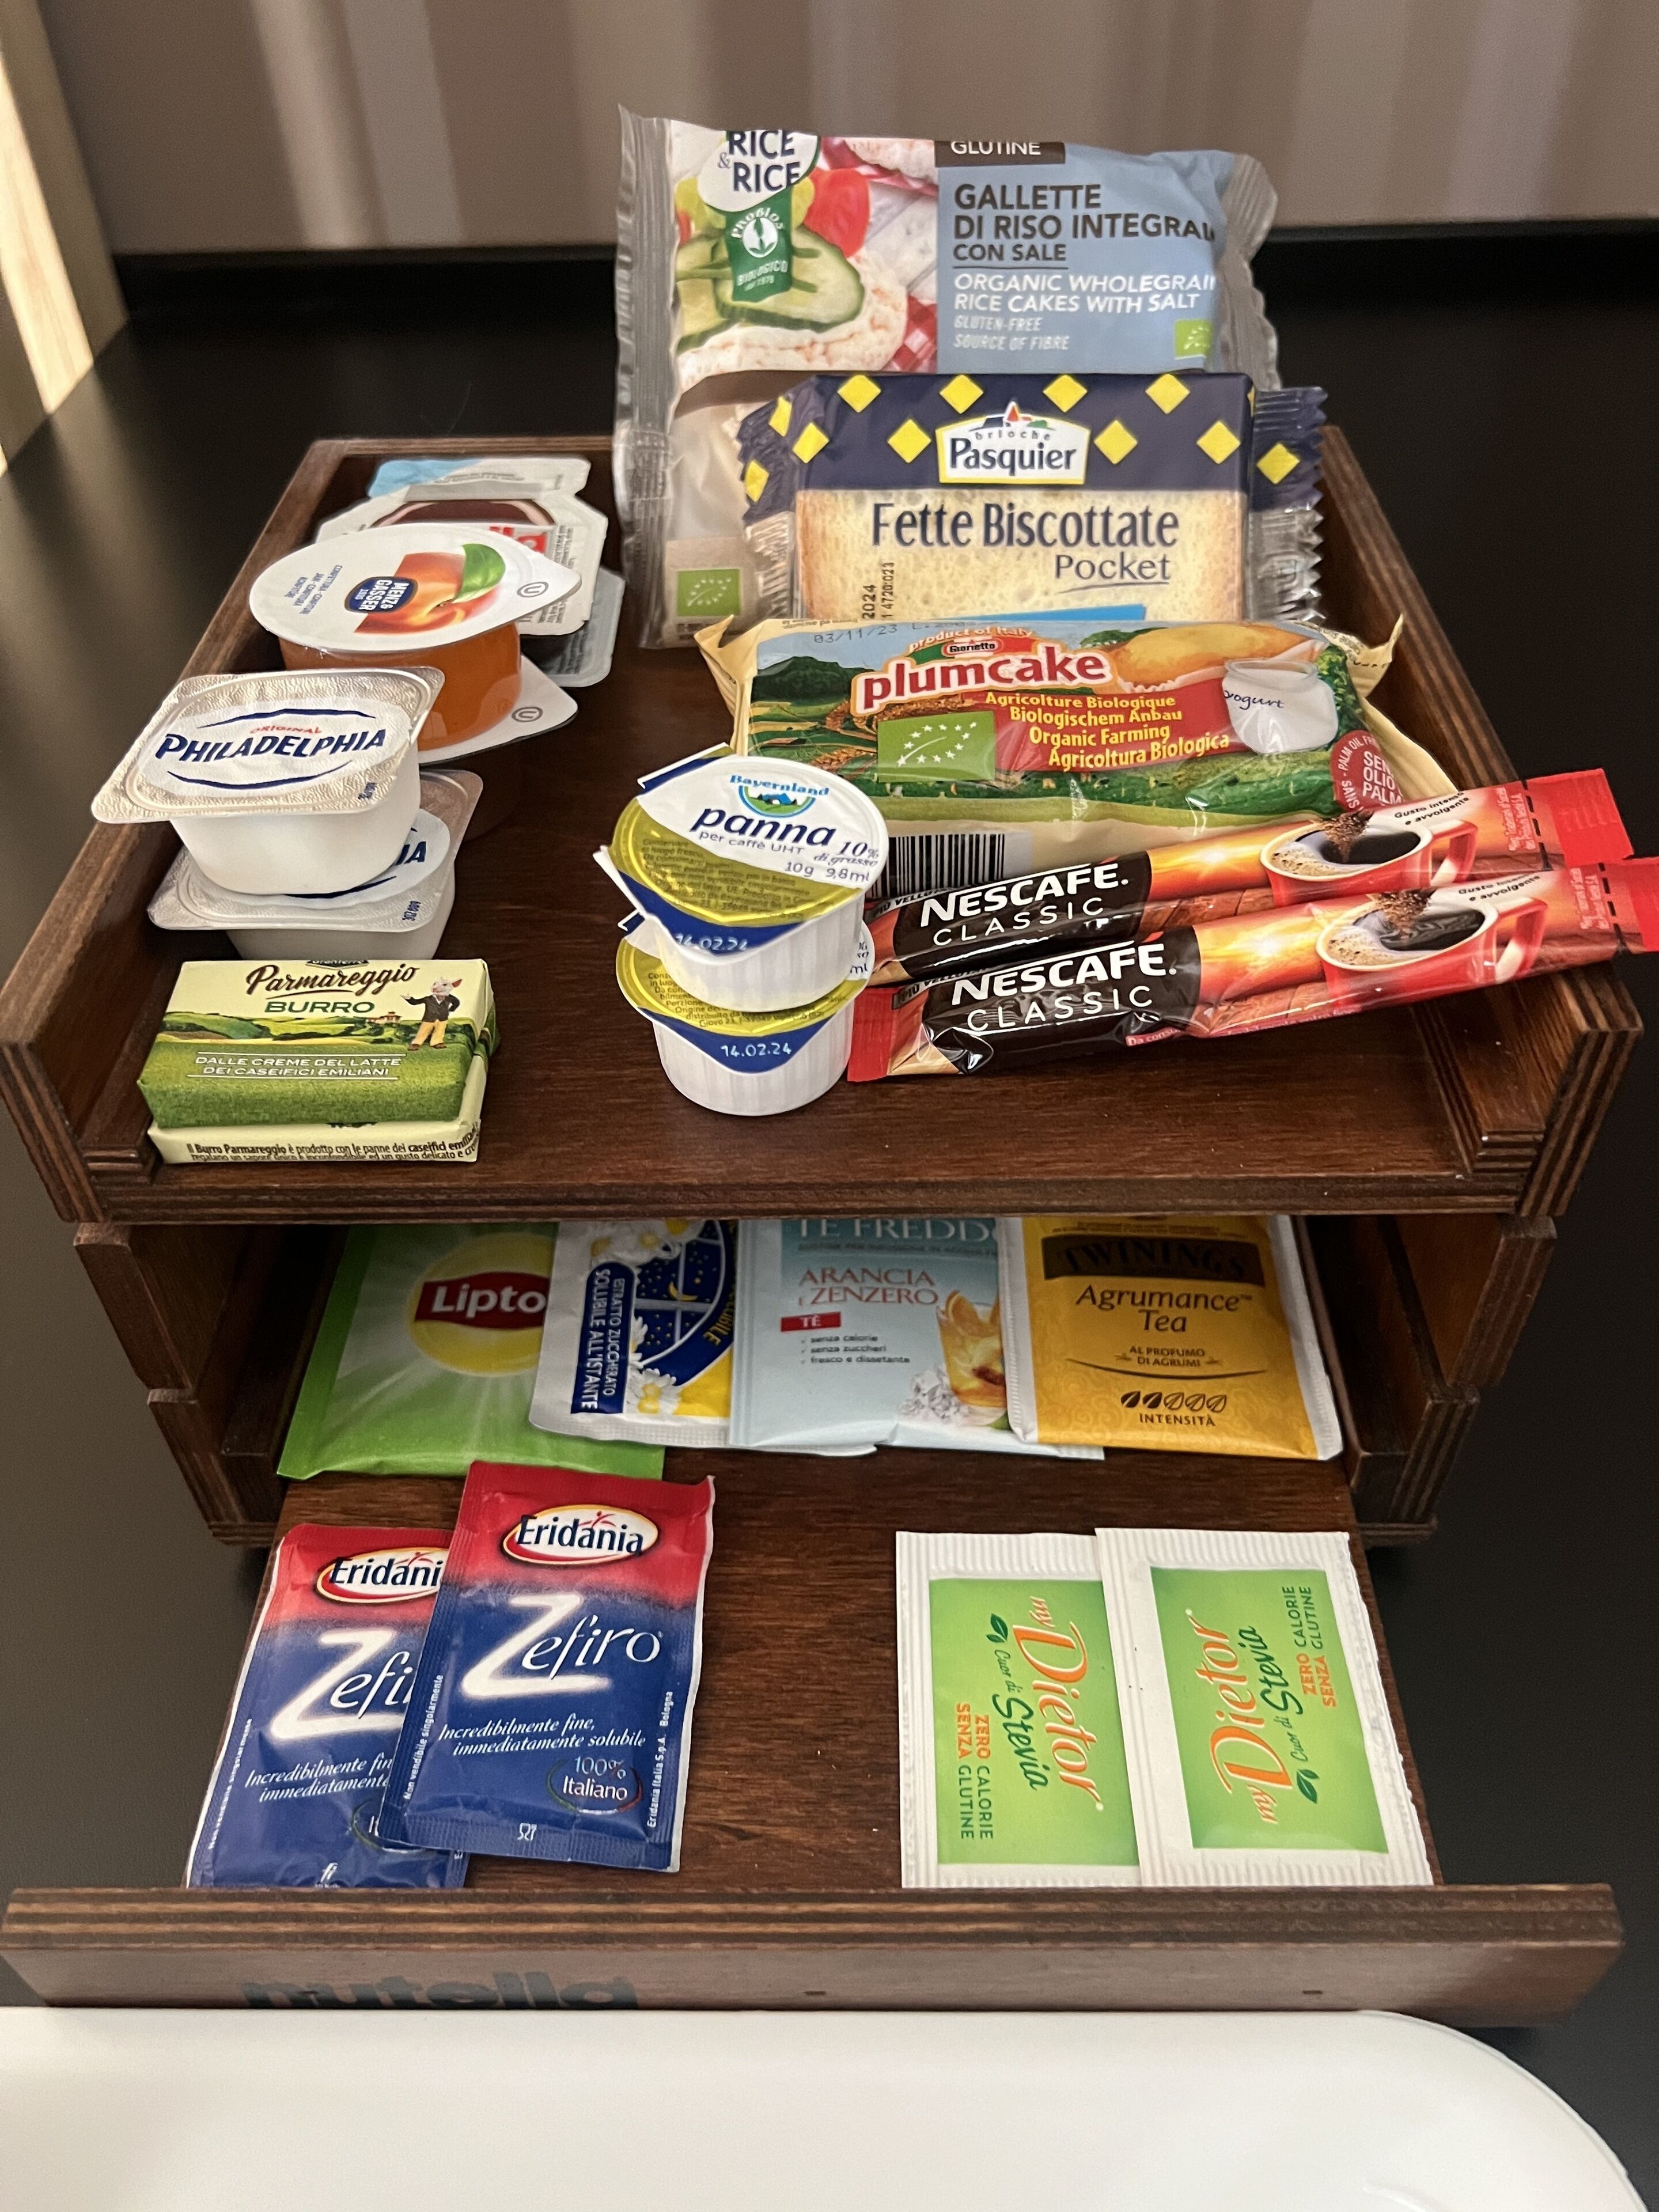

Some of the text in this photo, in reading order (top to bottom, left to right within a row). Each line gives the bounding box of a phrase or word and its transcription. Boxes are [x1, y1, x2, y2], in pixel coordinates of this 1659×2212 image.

[728, 130, 795, 158] RICE
[950, 142, 1041, 156] GLUTINE
[718, 152, 731, 169] &
[733, 161, 801, 192] RICE
[954, 184, 1101, 210] GALLETTE
[954, 215, 983, 240] DI
[994, 215, 1062, 240] RISO
[953, 244, 1066, 262] CON SALE
[954, 273, 1062, 292] ORGANIC
[954, 293, 1200, 313] RICE CAKES WITH SALT
[953, 315, 1042, 332] GLUTEN-FREE
[953, 334, 1070, 350] SOURCE OF FIBRE
[975, 430, 1052, 442] brioche
[950, 438, 1077, 477] Pasquier
[872, 502, 1179, 548] Fette Biscottate
[1055, 552, 1171, 581] Pocket
[359, 579, 393, 611] GASSER
[862, 584, 876, 619] 2024
[910, 628, 969, 652] product
[996, 626, 1033, 638] Italy
[864, 645, 1105, 710] plumcake
[986, 692, 1176, 712] Agricolture Biologique
[1224, 690, 1285, 710] yogurt
[250, 725, 322, 734] ORIGINAL
[1010, 707, 1183, 730] Biologischem Anbau
[155, 729, 386, 763] PHILADELPHIA
[1029, 724, 1170, 749] Organic Farming
[1048, 733, 1230, 772] Agricoltura Biologica
[1338, 737, 1365, 809] SANS PALM OIL
[1363, 767, 1395, 790] OLIO
[729, 775, 830, 797] Bayernland
[1395, 806, 1427, 819] Gusto
[1415, 797, 1470, 822] avvolgente
[690, 808, 837, 847] panna
[699, 830, 805, 855] per caffè UHT
[839, 840, 880, 859] 10%
[813, 853, 879, 868] di grasso
[825, 866, 870, 882] 9,8ml
[1459, 884, 1494, 895] Gusto
[1480, 875, 1541, 900] avvolgente
[933, 897, 1104, 946] CLASSIC
[246, 963, 420, 997] Parmareggio
[264, 1001, 375, 1013] BURRO
[967, 985, 1153, 1032] CLASSIC
[721, 1041, 792, 1058] 14.02.24
[1127, 1036, 1143, 1046] Da
[195, 1056, 402, 1066] DALLE CREME DEL LATTE
[194, 1143, 222, 1154] Burro
[224, 1143, 287, 1156] Parmareggio
[296, 1143, 334, 1156] prodotto
[335, 1145, 351, 1154] con
[351, 1143, 361, 1153] le
[363, 1144, 390, 1156] panne
[422, 1150, 456, 1160] delicato
[1064, 1239, 1245, 1274] TWININGS
[798, 1267, 937, 1286] ARANCIA
[430, 1283, 547, 1319] Lipto
[810, 1286, 939, 1305] ZENZERO
[1138, 1309, 1187, 1333] Tea
[810, 1334, 878, 1343] senza calorie
[810, 1344, 887, 1353] senza zuccheri
[810, 1355, 843, 1364] fresco
[856, 1355, 910, 1364] dissetante
[1129, 1346, 1206, 1358] AL PROFUMO
[1137, 1358, 1200, 1367] DI AGRUMI
[581, 1329, 605, 1410] ALL'ISTANTE
[1139, 1412, 1217, 1427] INTENSITÀ
[517, 1515, 645, 1555] Eridania
[330, 1558, 444, 1588] Eridani
[1029, 1596, 1056, 1628] my
[460, 1592, 662, 1699] Zefiro
[1281, 1585, 1317, 1696] ZERO CALORIE
[1298, 1585, 1336, 1709] SENZA GLUTINE
[1188, 1613, 1293, 1793] Dietor
[1238, 1624, 1309, 1762] Cuor di Stevia
[992, 1649, 1049, 1790] Cuor di Stevia
[1012, 1621, 1101, 1804] Dietor
[403, 1675, 444, 1800] Non vendibile singolarmente
[438, 1713, 596, 1741] Incredibilmente fine,
[453, 1729, 647, 1756] immediatamente solubile
[575, 1756, 627, 1780] 100%
[647, 1691, 674, 1828] Eridania Italia Bologna
[956, 1703, 975, 1840] SENZA GLUTINE
[246, 1756, 365, 1789] Incredibilmente
[975, 1714, 994, 1840] ZERO CALORIE
[563, 1775, 629, 1802] Italiano
[1247, 1783, 1278, 1825] my
[243, 1971, 638, 2010] nutella
